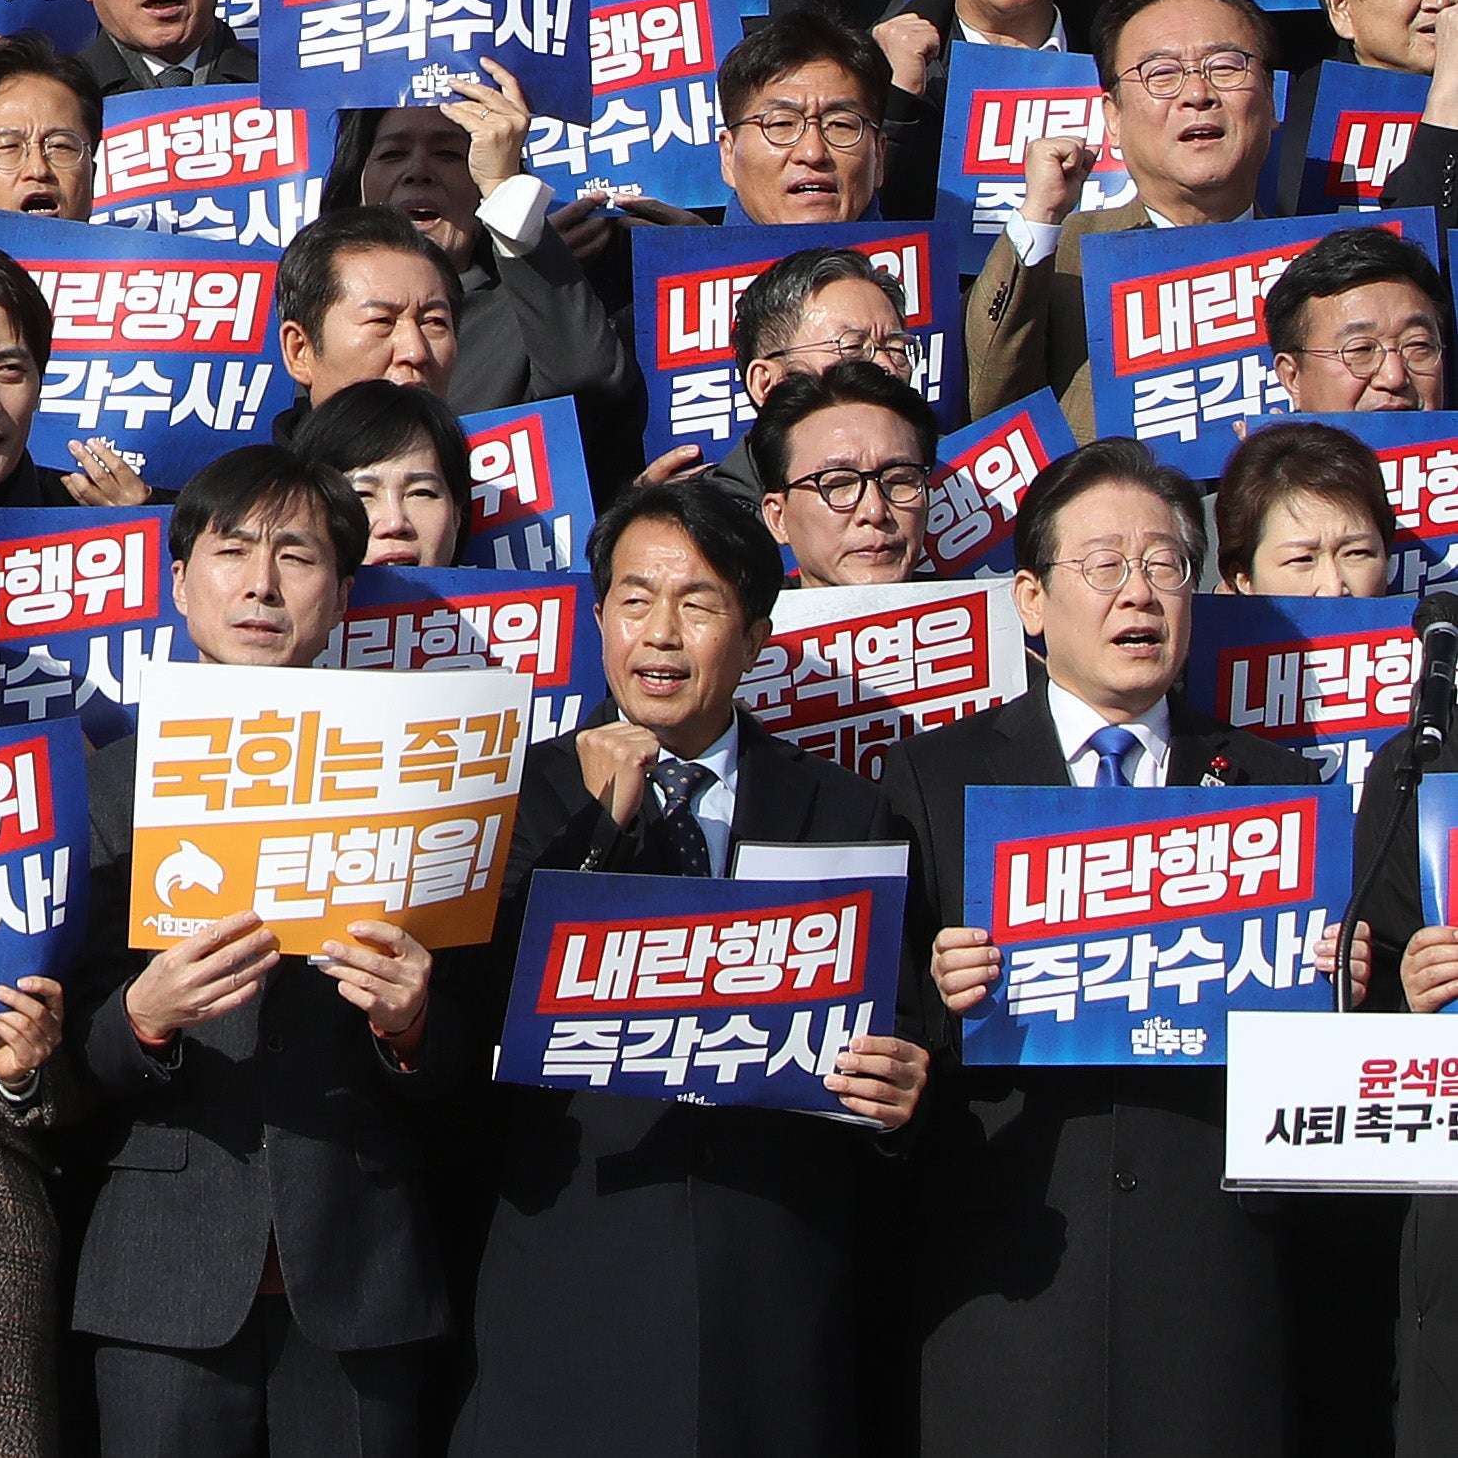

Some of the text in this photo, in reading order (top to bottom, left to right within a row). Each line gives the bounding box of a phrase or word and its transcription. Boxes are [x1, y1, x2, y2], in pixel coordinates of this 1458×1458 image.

[152, 708, 521, 813] 국회는 즉각
[252, 813, 503, 920] 탄핵을!
[1009, 811, 1300, 928] 내란행위
[555, 905, 858, 1001] 내란행위
[1131, 1028, 1207, 1057] 민주당
[1264, 1104, 1347, 1147] 사퇴
